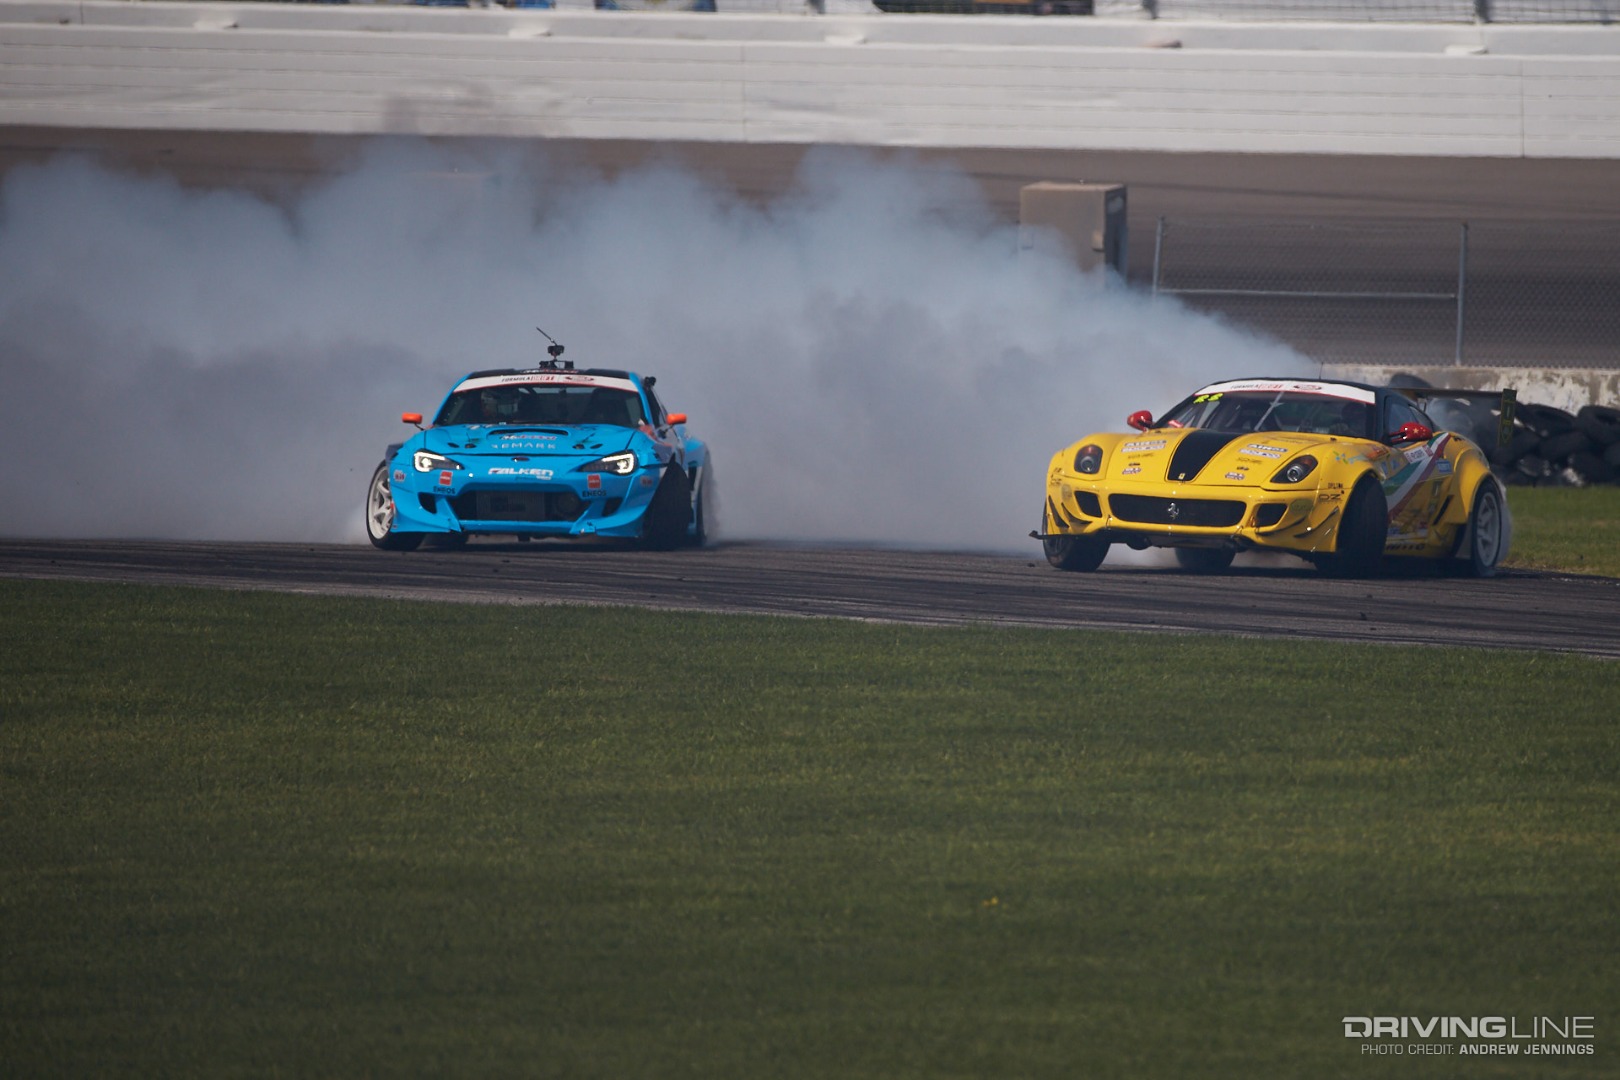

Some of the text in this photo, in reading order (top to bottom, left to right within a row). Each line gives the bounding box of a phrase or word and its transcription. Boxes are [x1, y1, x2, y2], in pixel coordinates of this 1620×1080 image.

[488, 467, 554, 477] FALKEN
[433, 485, 456, 495] ENEOS
[582, 489, 607, 497] ENEOS
